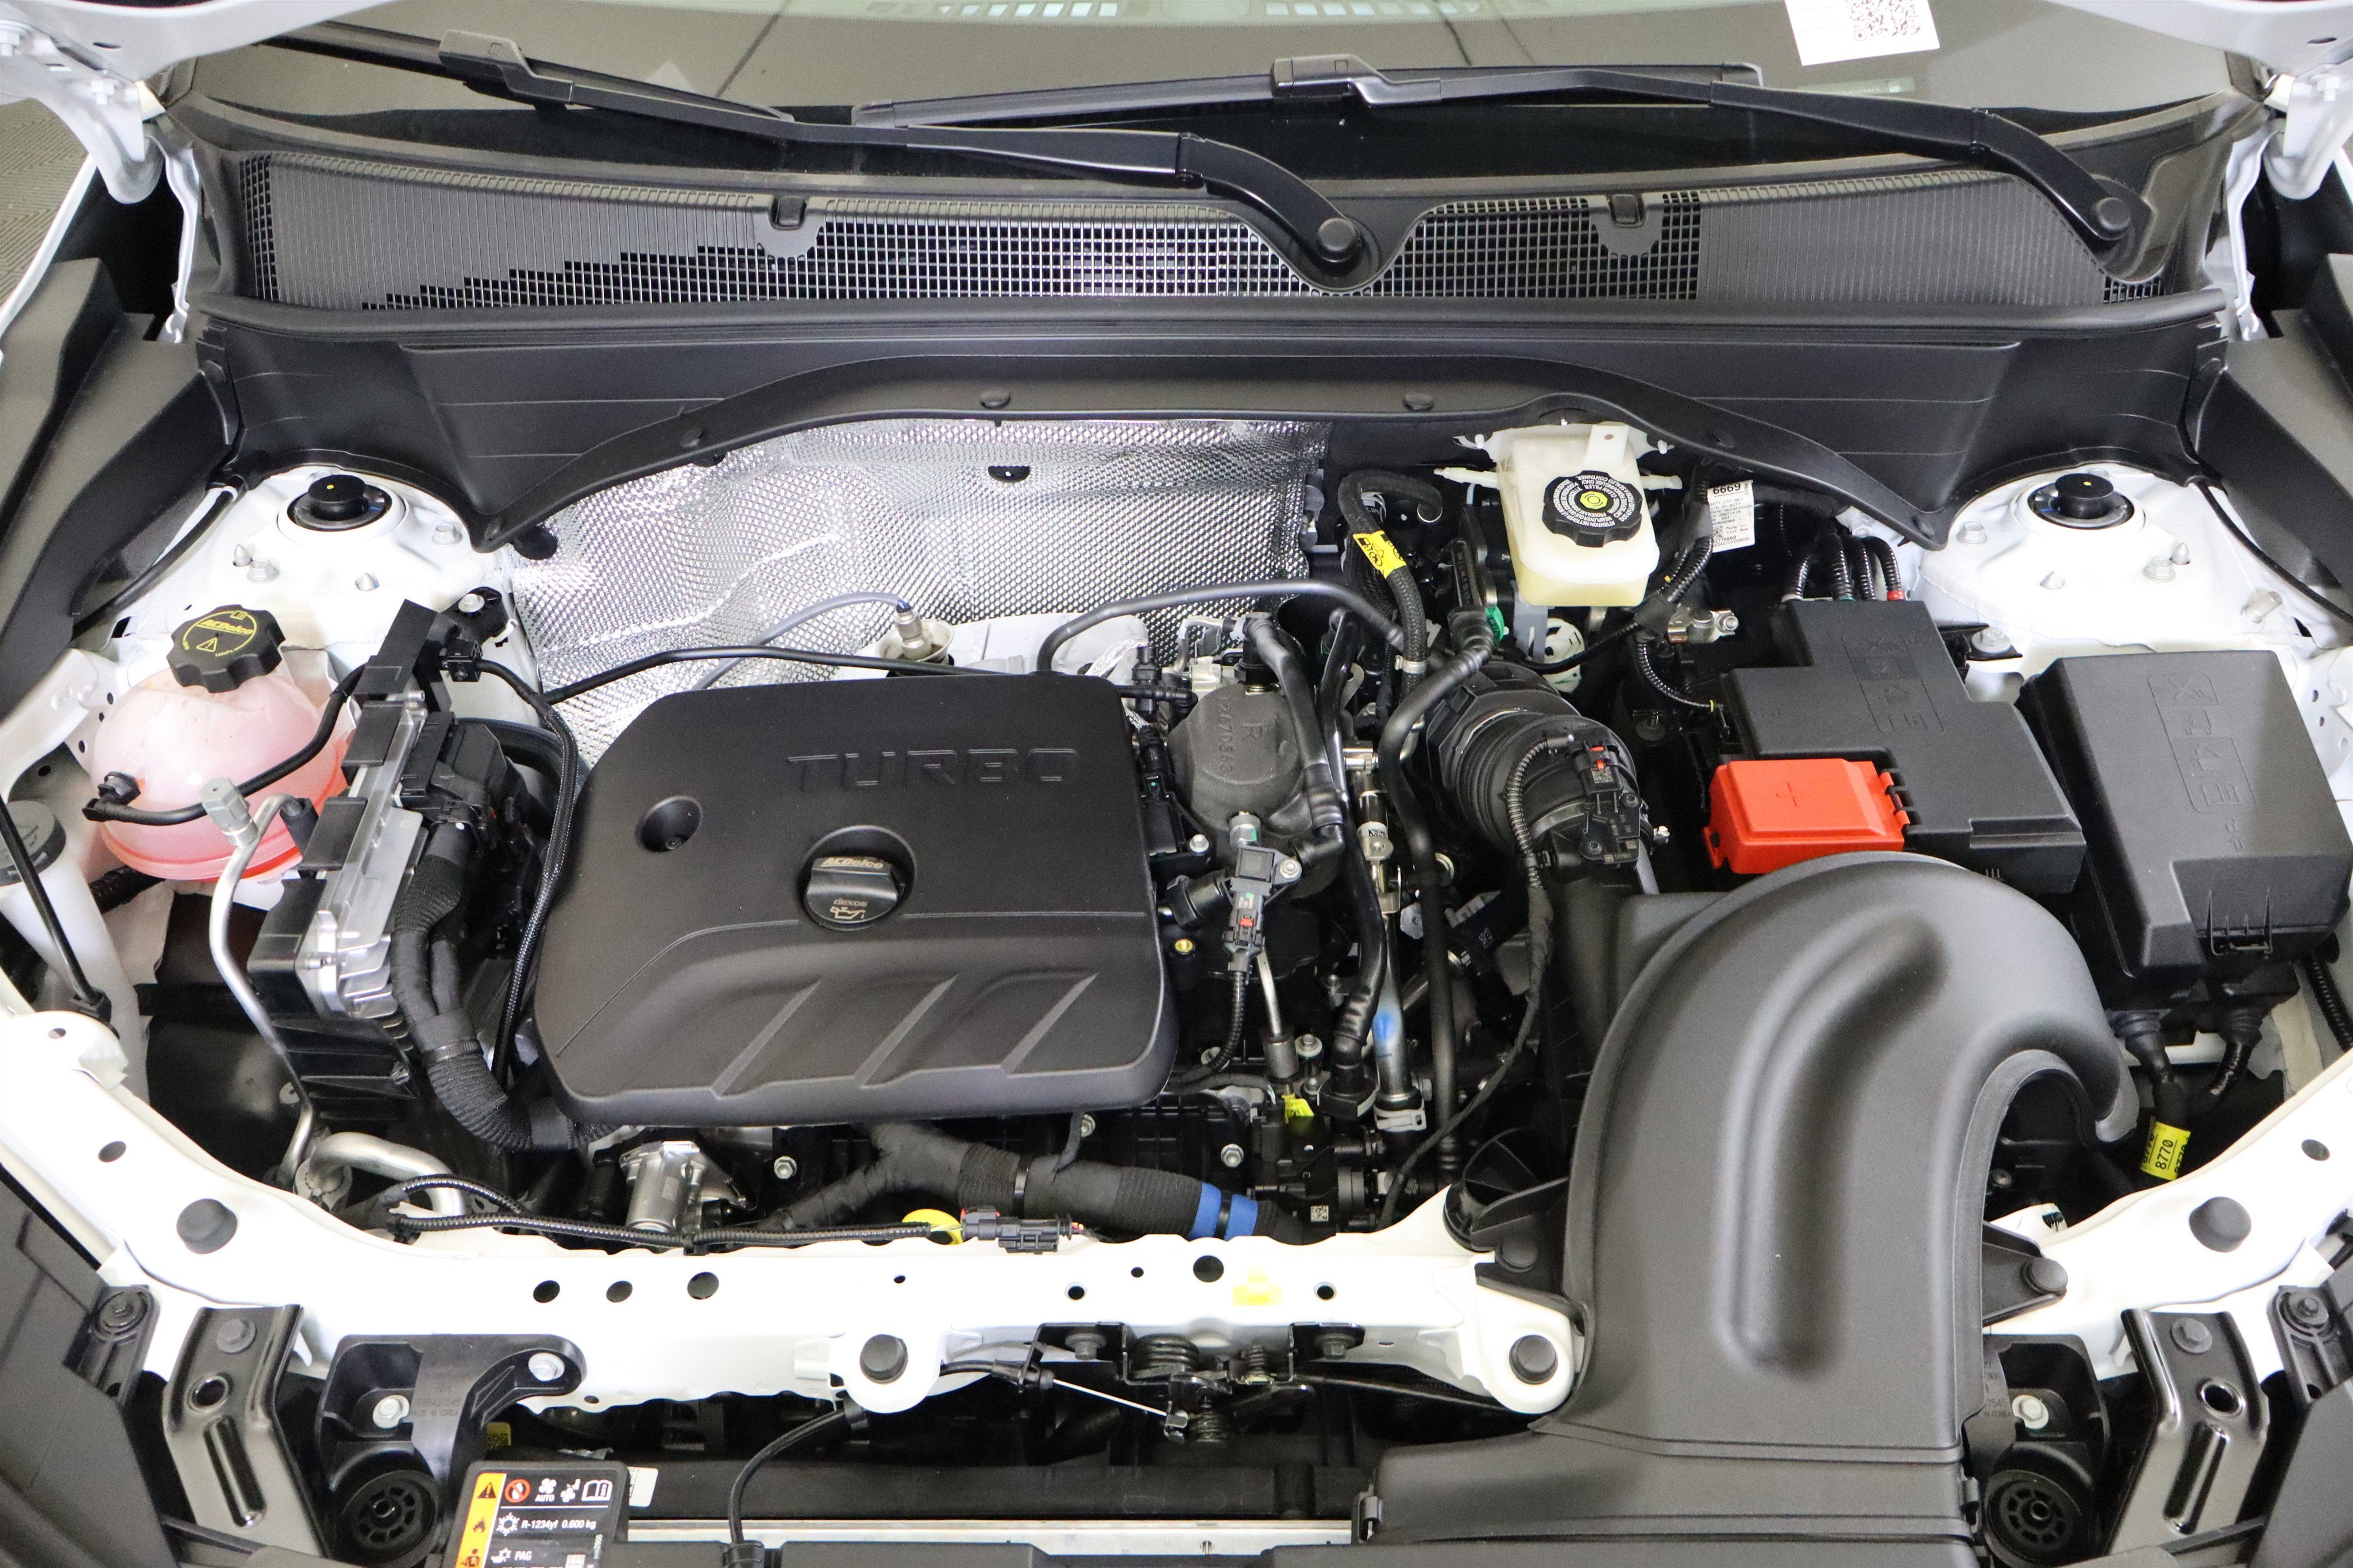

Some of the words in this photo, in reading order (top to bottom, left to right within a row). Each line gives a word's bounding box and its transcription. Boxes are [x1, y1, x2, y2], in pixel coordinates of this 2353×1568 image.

[1607, 478, 1627, 490] SEALED
[1713, 483, 1741, 494] 6669
[201, 619, 253, 635] ACDelco
[788, 748, 1079, 791] TURBO
[821, 857, 884, 868] ACDelco
[833, 898, 868, 907] dexos
[2155, 1140, 2174, 1169] 8770
[535, 1494, 555, 1502] AUTO
[521, 1519, 558, 1530] R-1234yf
[562, 1519, 585, 1529] 0.600
[585, 1520, 597, 1530] kg
[514, 1551, 532, 1561] PAG
